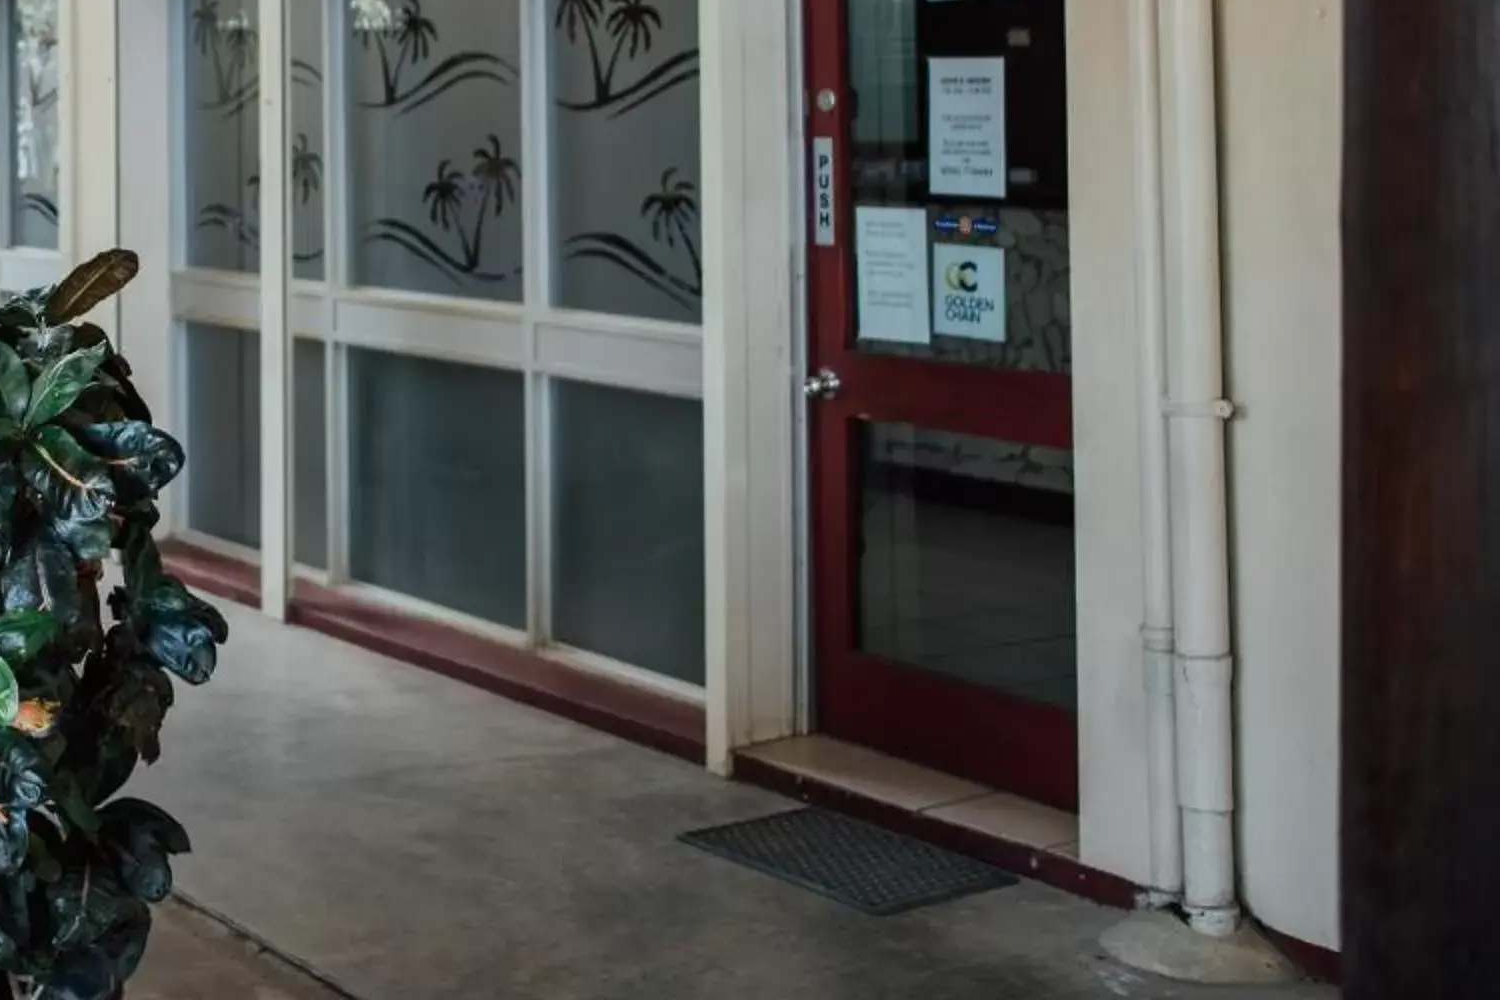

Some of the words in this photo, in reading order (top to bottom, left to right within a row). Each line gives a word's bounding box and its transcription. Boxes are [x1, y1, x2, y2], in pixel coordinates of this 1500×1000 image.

[817, 154, 831, 228] PUSH
[944, 293, 995, 311] GOLDEN
[944, 306, 982, 324] CHAIN
